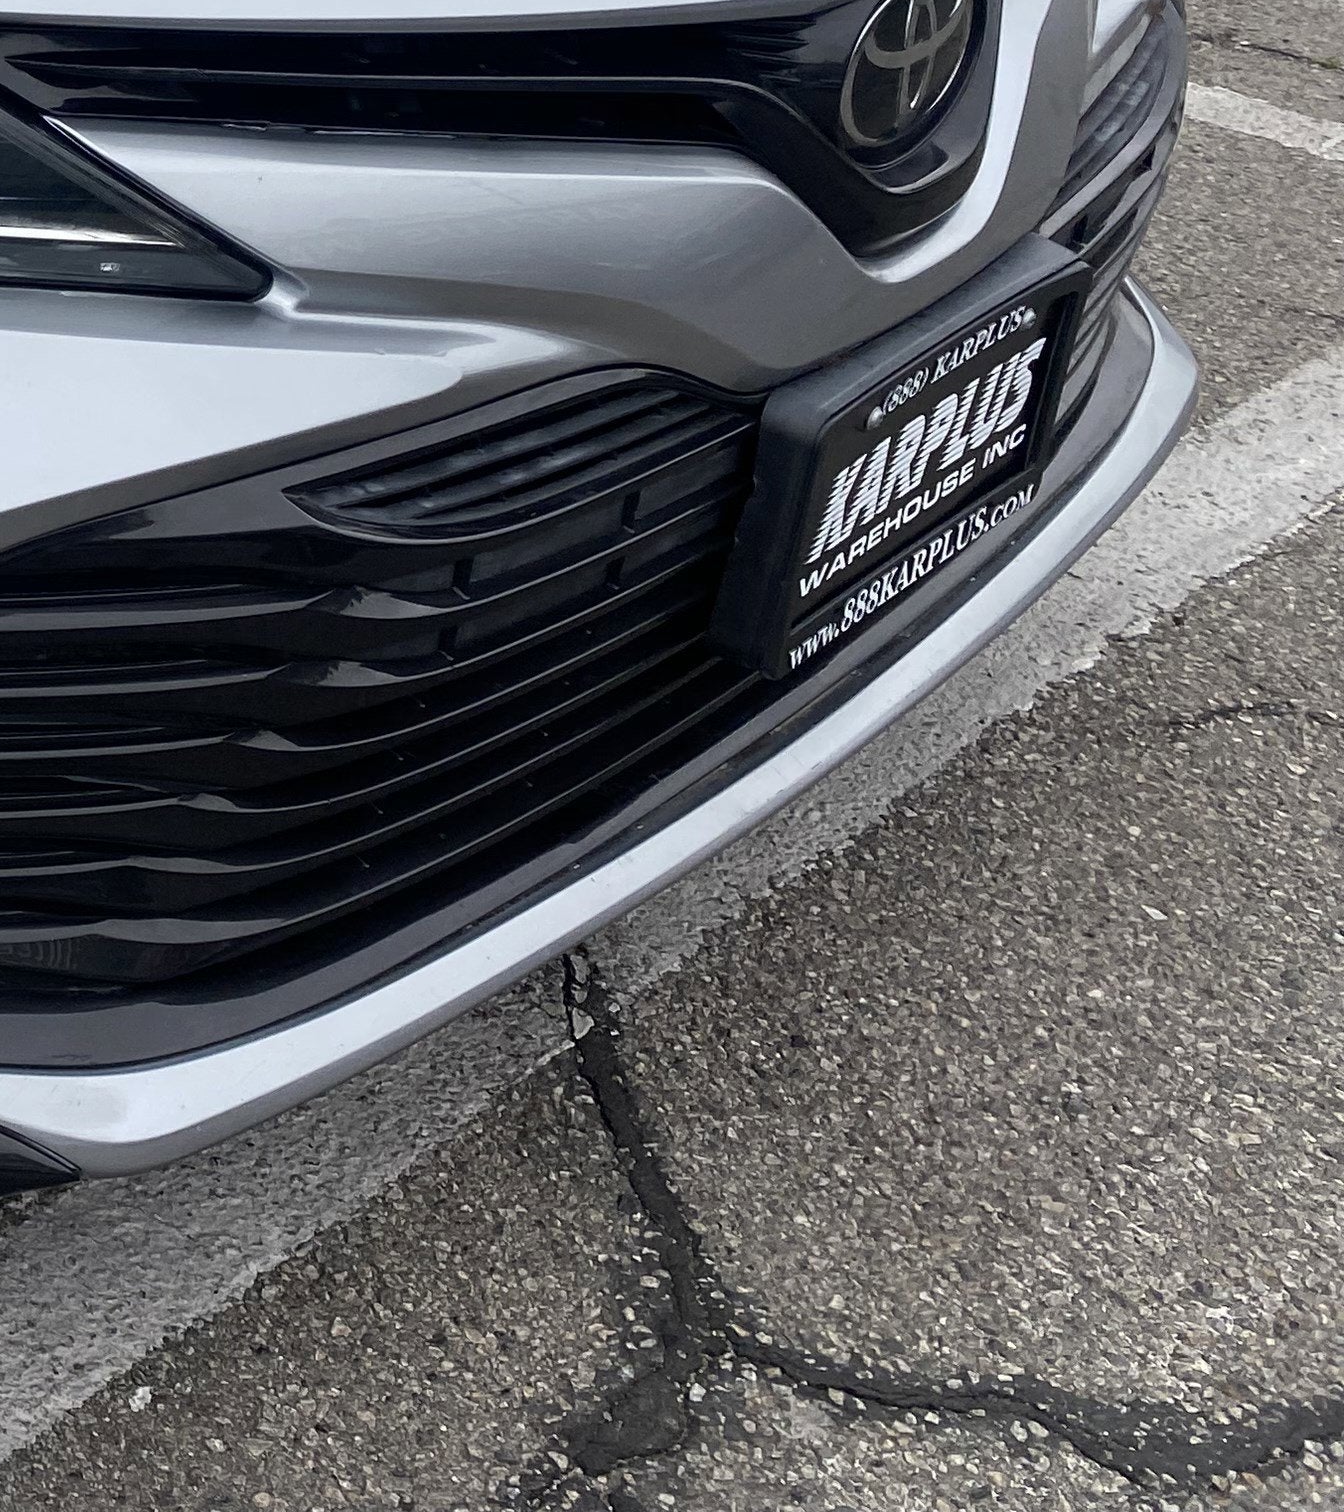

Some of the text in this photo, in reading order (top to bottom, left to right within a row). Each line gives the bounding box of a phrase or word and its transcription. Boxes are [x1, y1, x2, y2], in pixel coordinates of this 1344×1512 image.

[883, 305, 1027, 415] (888) KARPLUS
[799, 423, 1027, 597] WAREHOUSE INC
[803, 337, 1047, 565] KARPLUS
